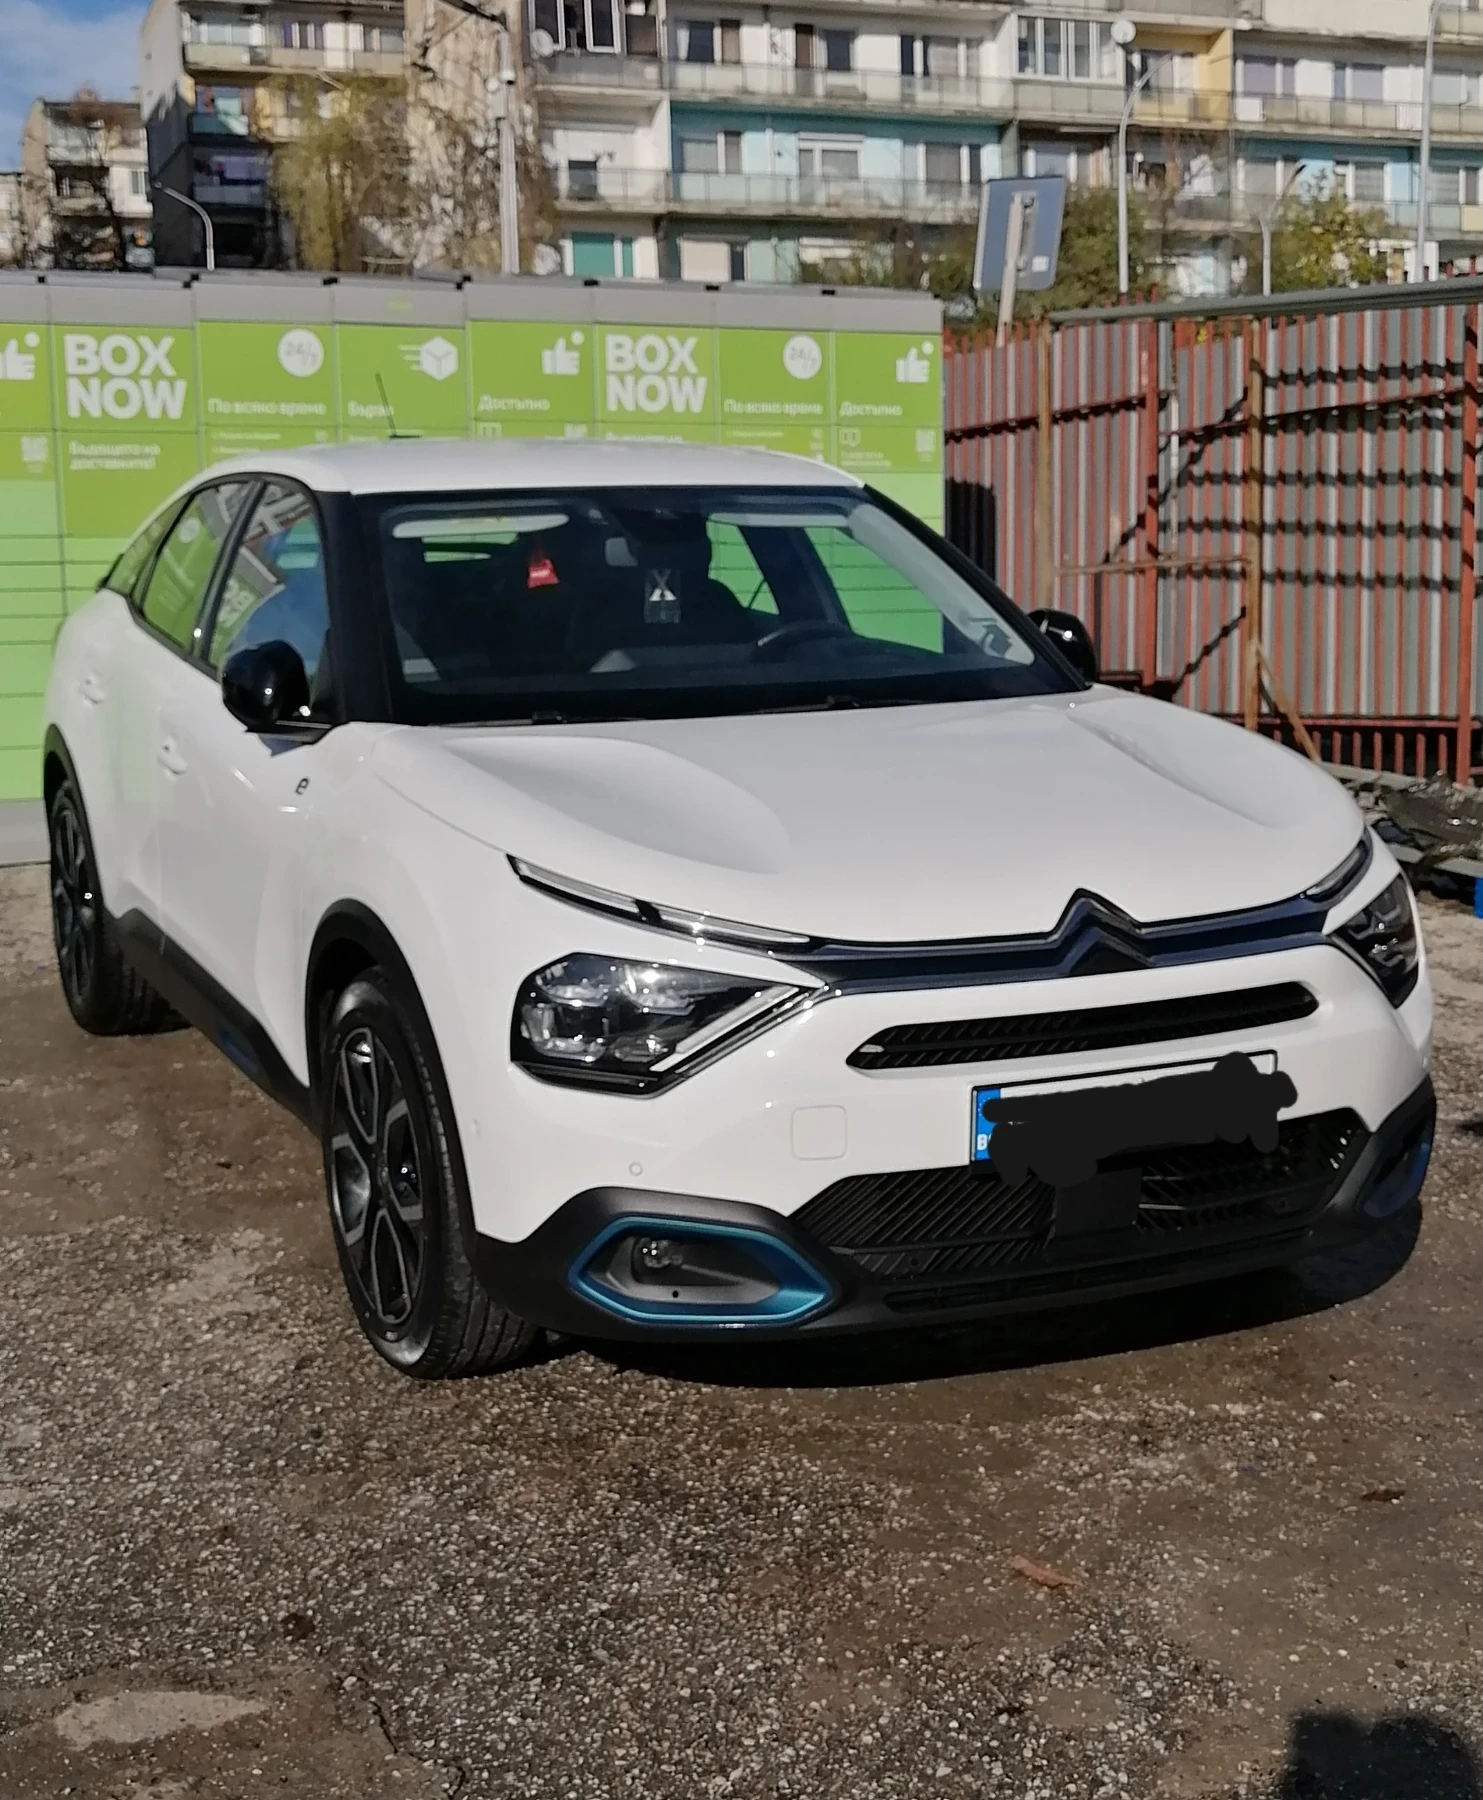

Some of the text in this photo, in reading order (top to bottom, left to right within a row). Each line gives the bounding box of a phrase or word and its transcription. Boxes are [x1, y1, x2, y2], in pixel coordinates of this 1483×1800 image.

[64, 334, 176, 377] BOX
[283, 341, 319, 367] 24/7
[605, 334, 698, 374] BOX
[66, 377, 187, 420] NOW
[606, 375, 707, 413] NOW
[295, 777, 310, 797] e
